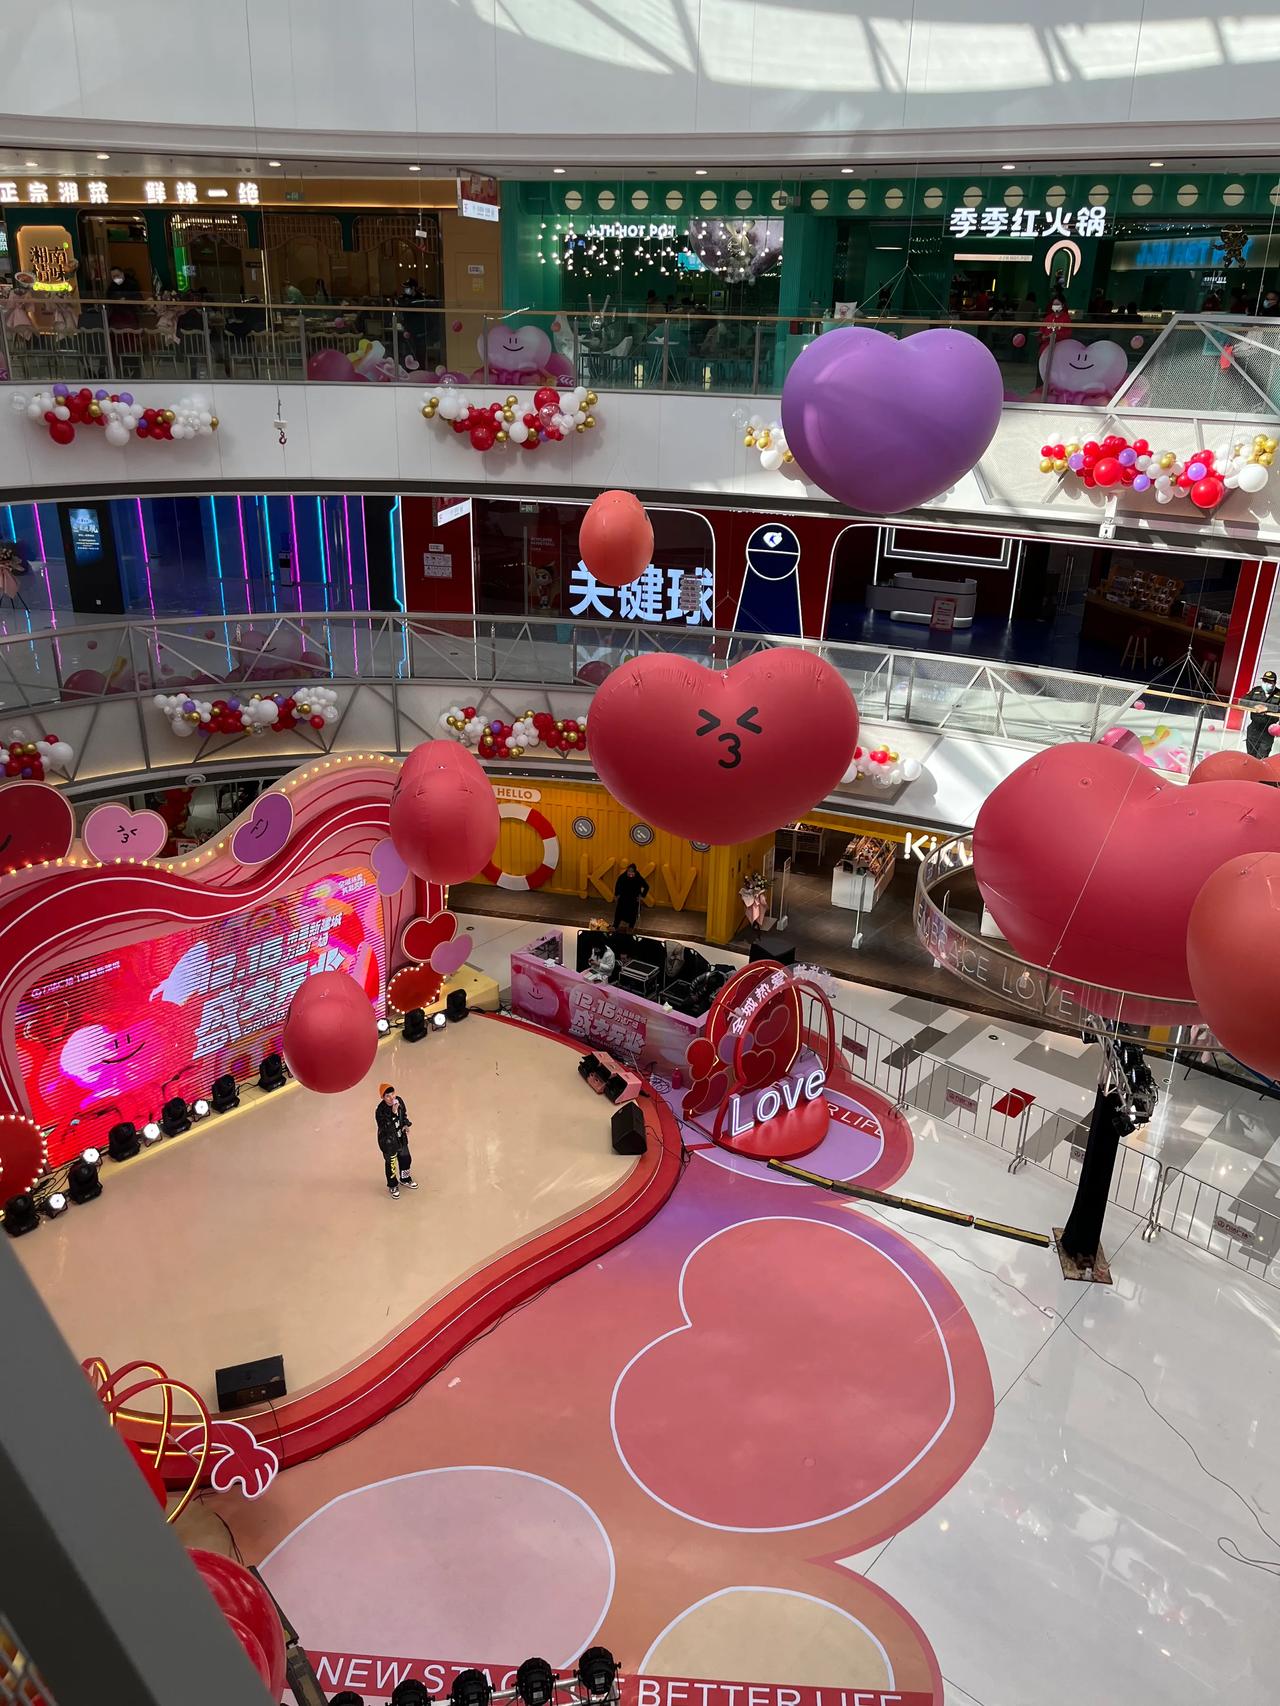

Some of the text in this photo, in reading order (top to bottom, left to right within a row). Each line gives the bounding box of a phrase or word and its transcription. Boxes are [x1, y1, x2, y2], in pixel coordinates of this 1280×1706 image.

[0, 182, 260, 205] 正宗湘菜 鲜辣一绝
[619, 224, 646, 238] HOT
[949, 206, 1107, 238] 季季红火锅
[569, 560, 714, 625] 关键球
[497, 787, 533, 800] HELLO
[572, 990, 617, 1020] 12.16
[1001, 966, 1075, 1016] LOVE
[568, 1009, 646, 1054] 盛大开业
[729, 1069, 826, 1138] Love
[315, 1656, 412, 1690] NEW
[638, 1679, 801, 1706] BETTER
